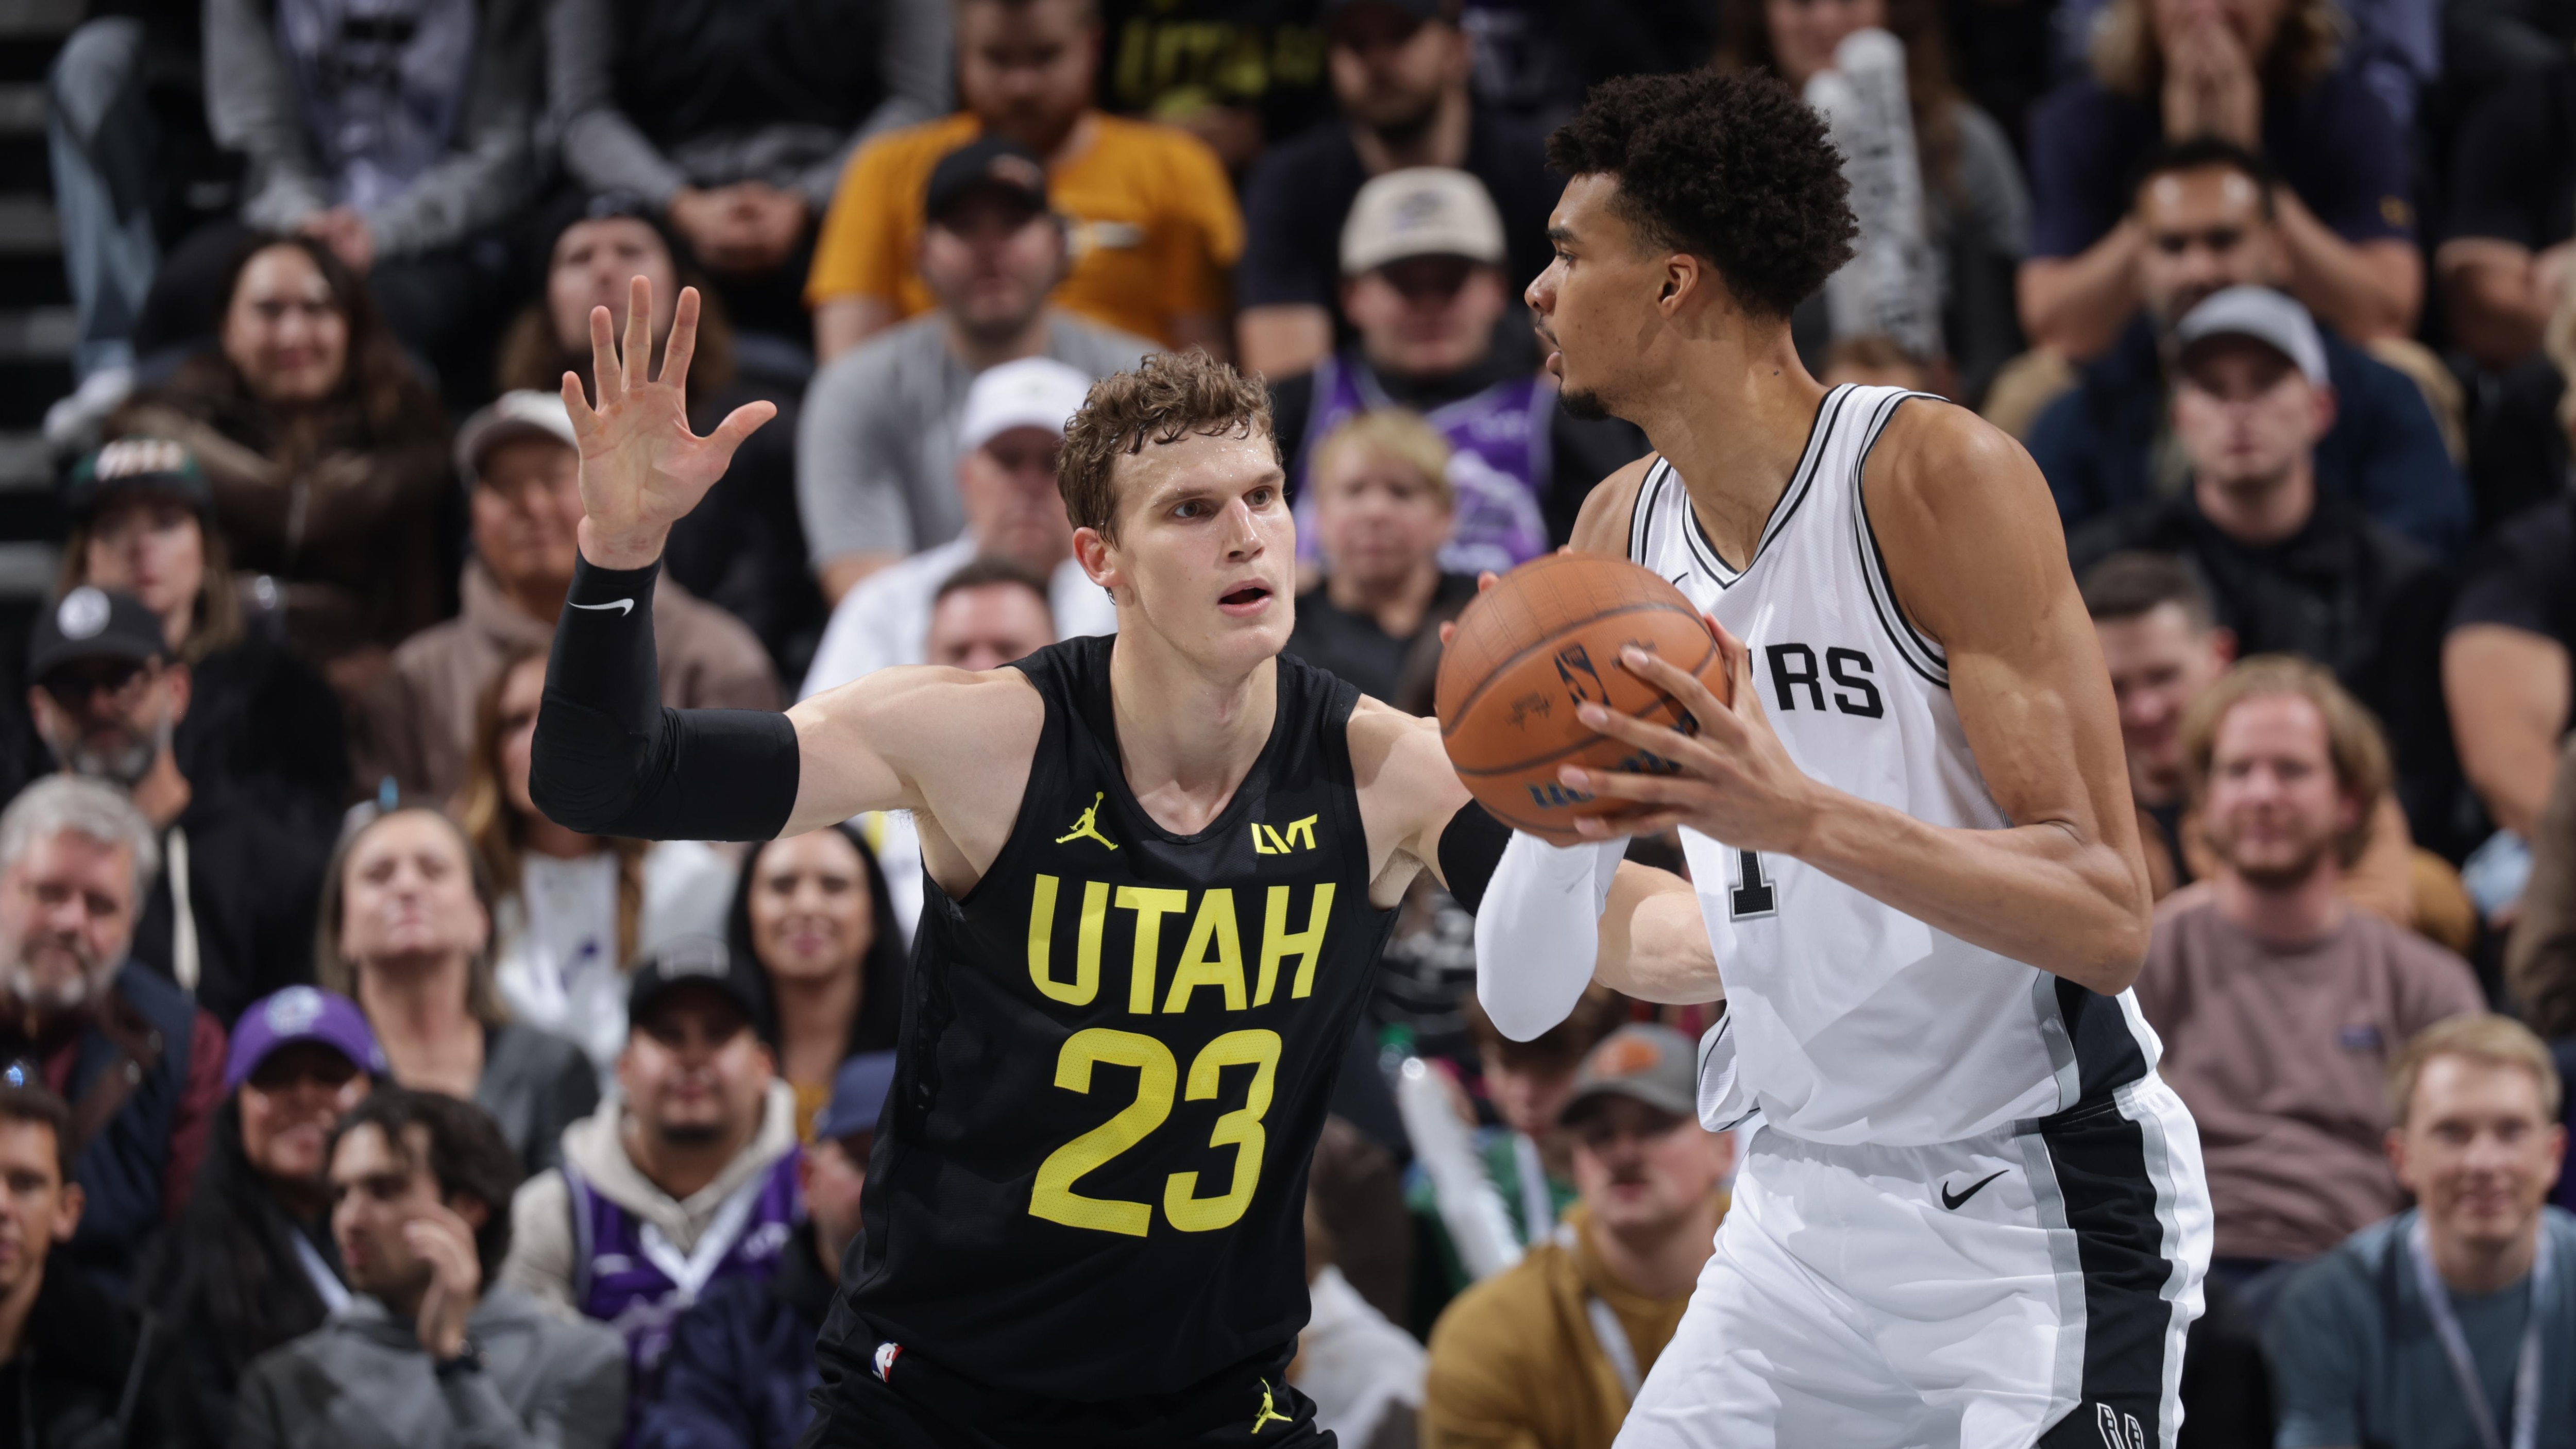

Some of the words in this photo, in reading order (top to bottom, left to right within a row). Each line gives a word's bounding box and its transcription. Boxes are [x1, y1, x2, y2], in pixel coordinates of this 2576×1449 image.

[1251, 814, 1318, 854] LVT
[1028, 874, 1336, 1014] UTAH
[1028, 1028, 1282, 1237] 23
